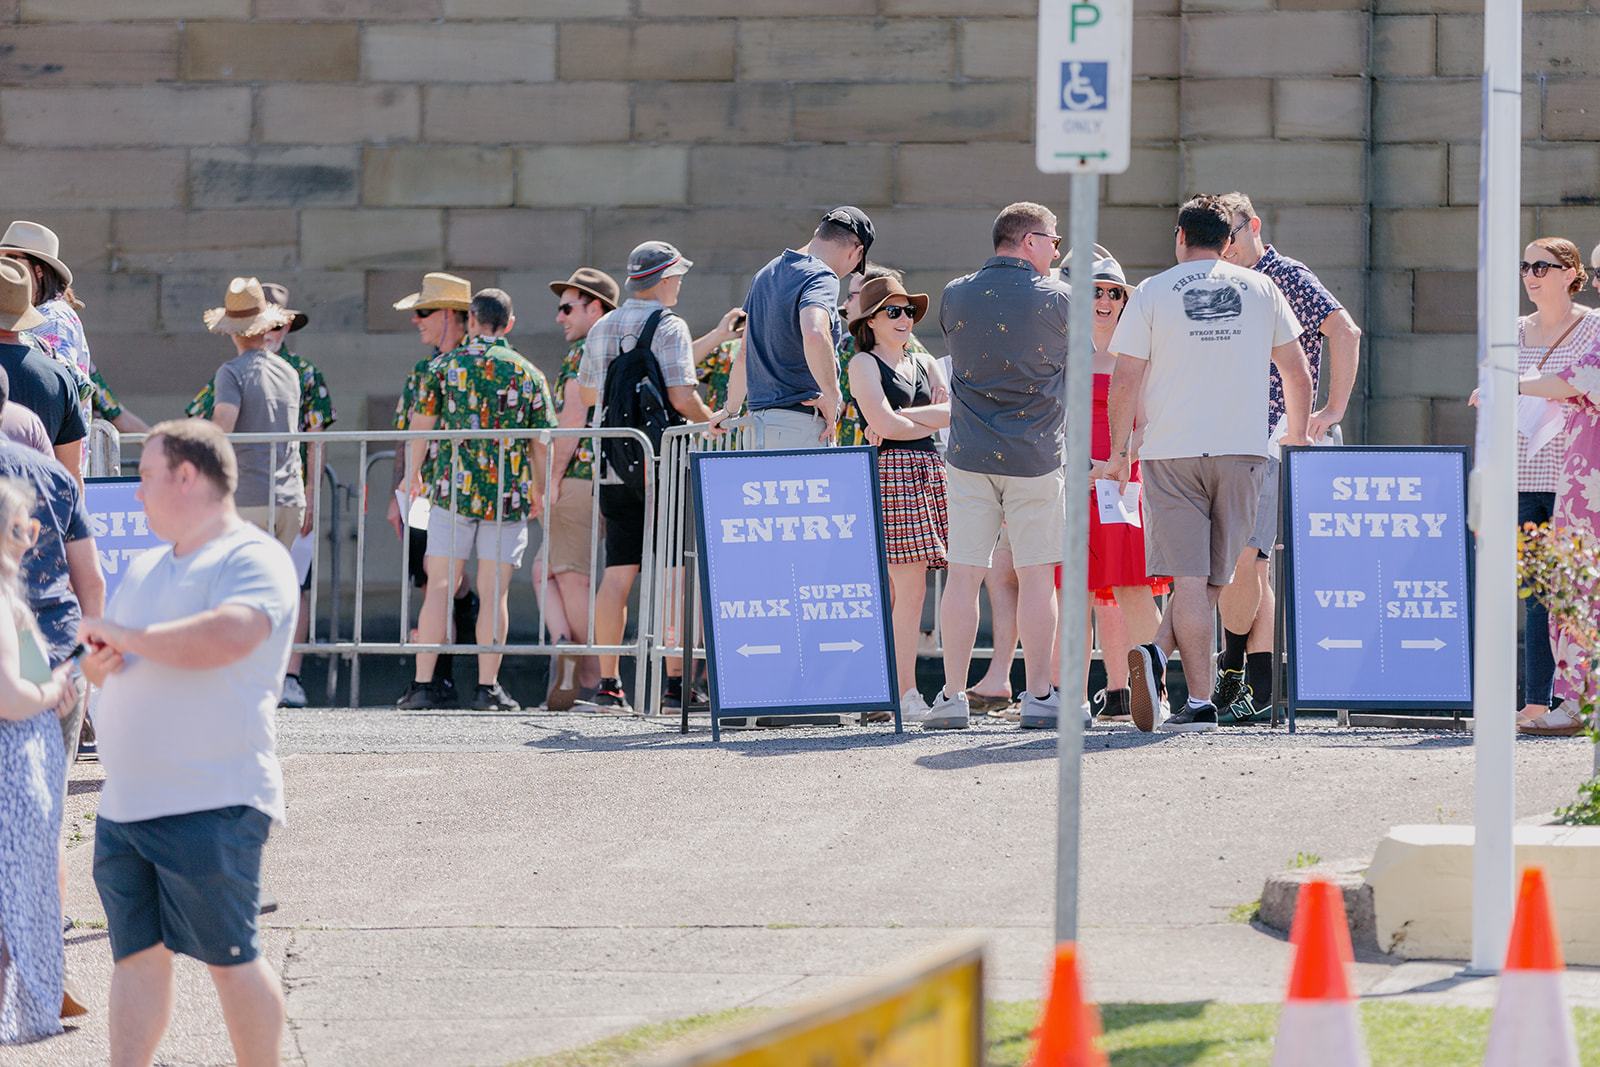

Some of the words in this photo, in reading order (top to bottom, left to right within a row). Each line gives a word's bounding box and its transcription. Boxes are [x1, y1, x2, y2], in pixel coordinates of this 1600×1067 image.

[1070, 4, 1101, 43] P
[1063, 119, 1103, 134] ONLY
[1230, 276, 1248, 291] CO
[742, 478, 831, 506] SITE
[1332, 477, 1422, 501] SITE
[89, 511, 149, 537] SIT
[720, 514, 857, 543] ENTRY
[1308, 513, 1447, 537] ENTRY
[799, 583, 873, 600] SUPER
[1314, 590, 1366, 608] VIP
[1393, 581, 1448, 598] TIX
[720, 599, 791, 619] MAX
[802, 600, 873, 620] MAX
[1386, 601, 1458, 619] SALE
